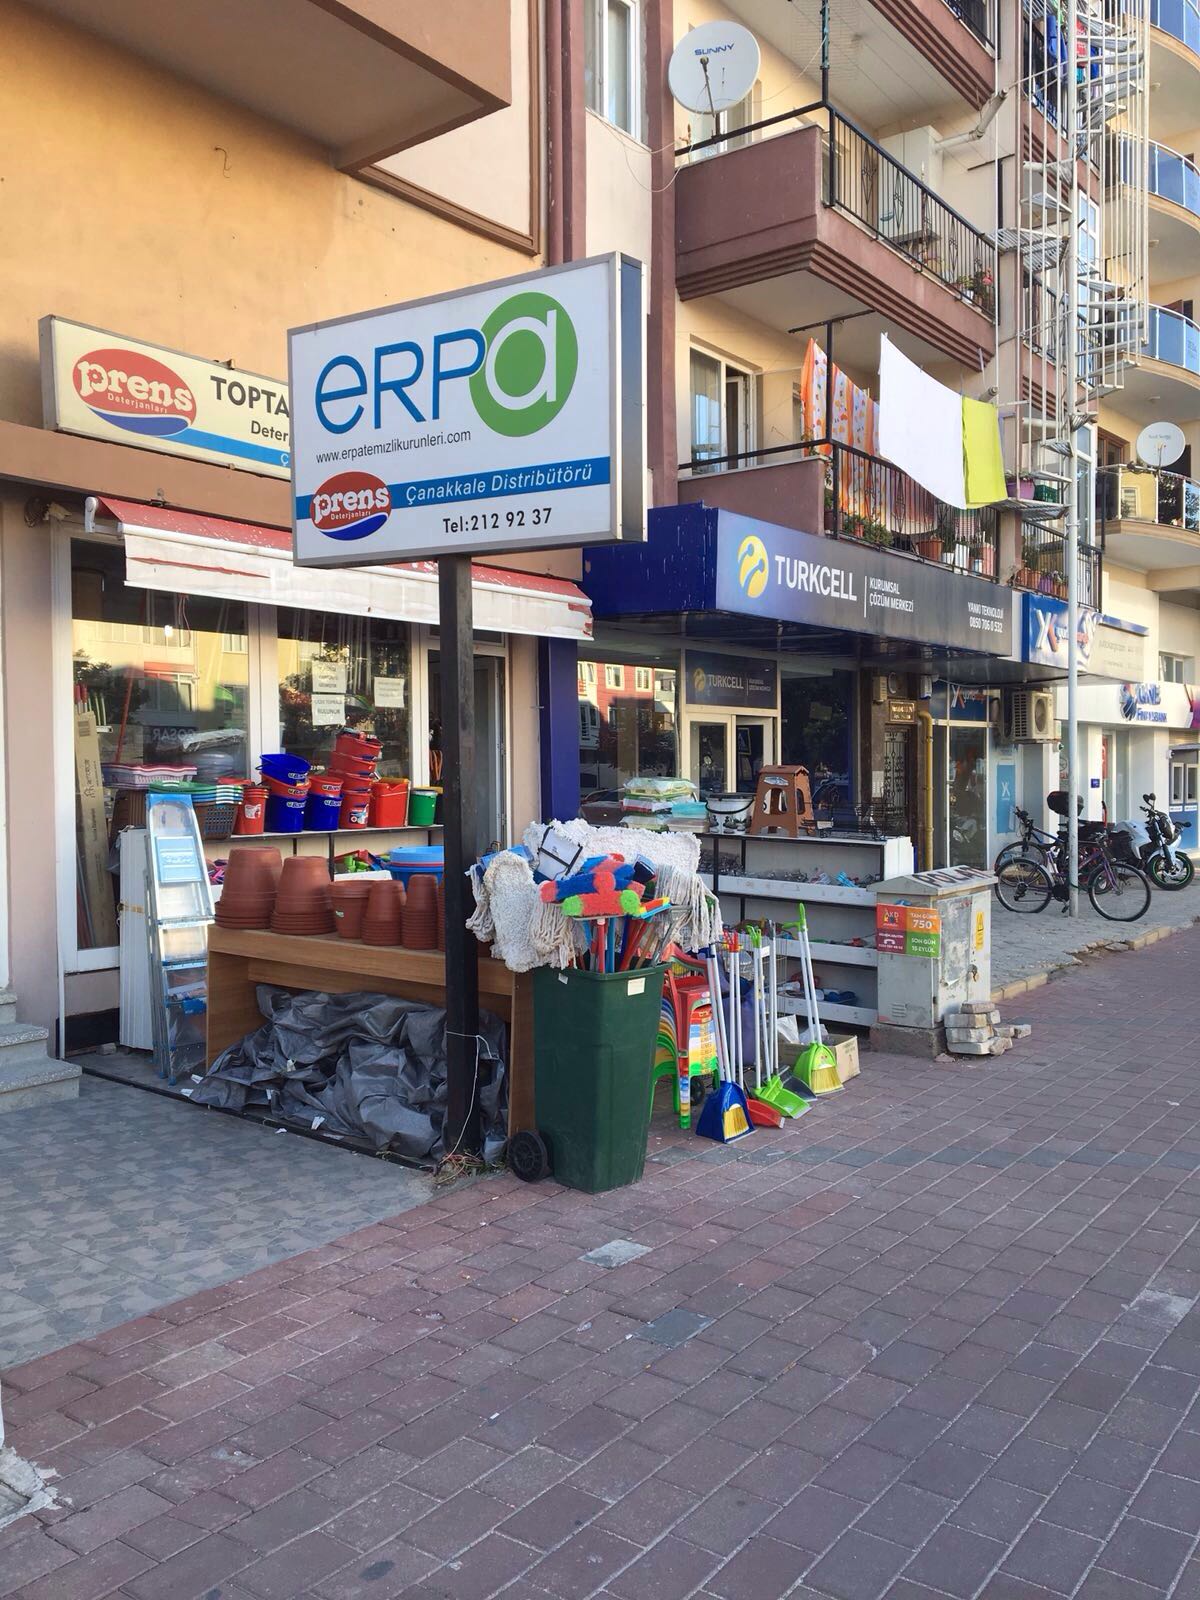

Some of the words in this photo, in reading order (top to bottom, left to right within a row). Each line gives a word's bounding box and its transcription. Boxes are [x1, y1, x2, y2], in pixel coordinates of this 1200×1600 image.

[694, 43, 735, 56] SUNNY
[77, 360, 193, 412] prens
[210, 376, 289, 418] TOPTA
[406, 479, 486, 505] Çanakkale
[491, 464, 593, 492] Distribütörü
[313, 487, 389, 525] prens
[443, 513, 500, 534] Tel:212
[506, 510, 525, 528] 92
[532, 507, 552, 526] 37
[775, 555, 857, 601] TURKCELL
[869, 577, 900, 595] KURUMSAL
[869, 591, 890, 608] ÇÖZÜM
[890, 597, 914, 613] MERKEZİ
[706, 674, 744, 690] TURKCELL
[912, 919, 933, 930] 750
